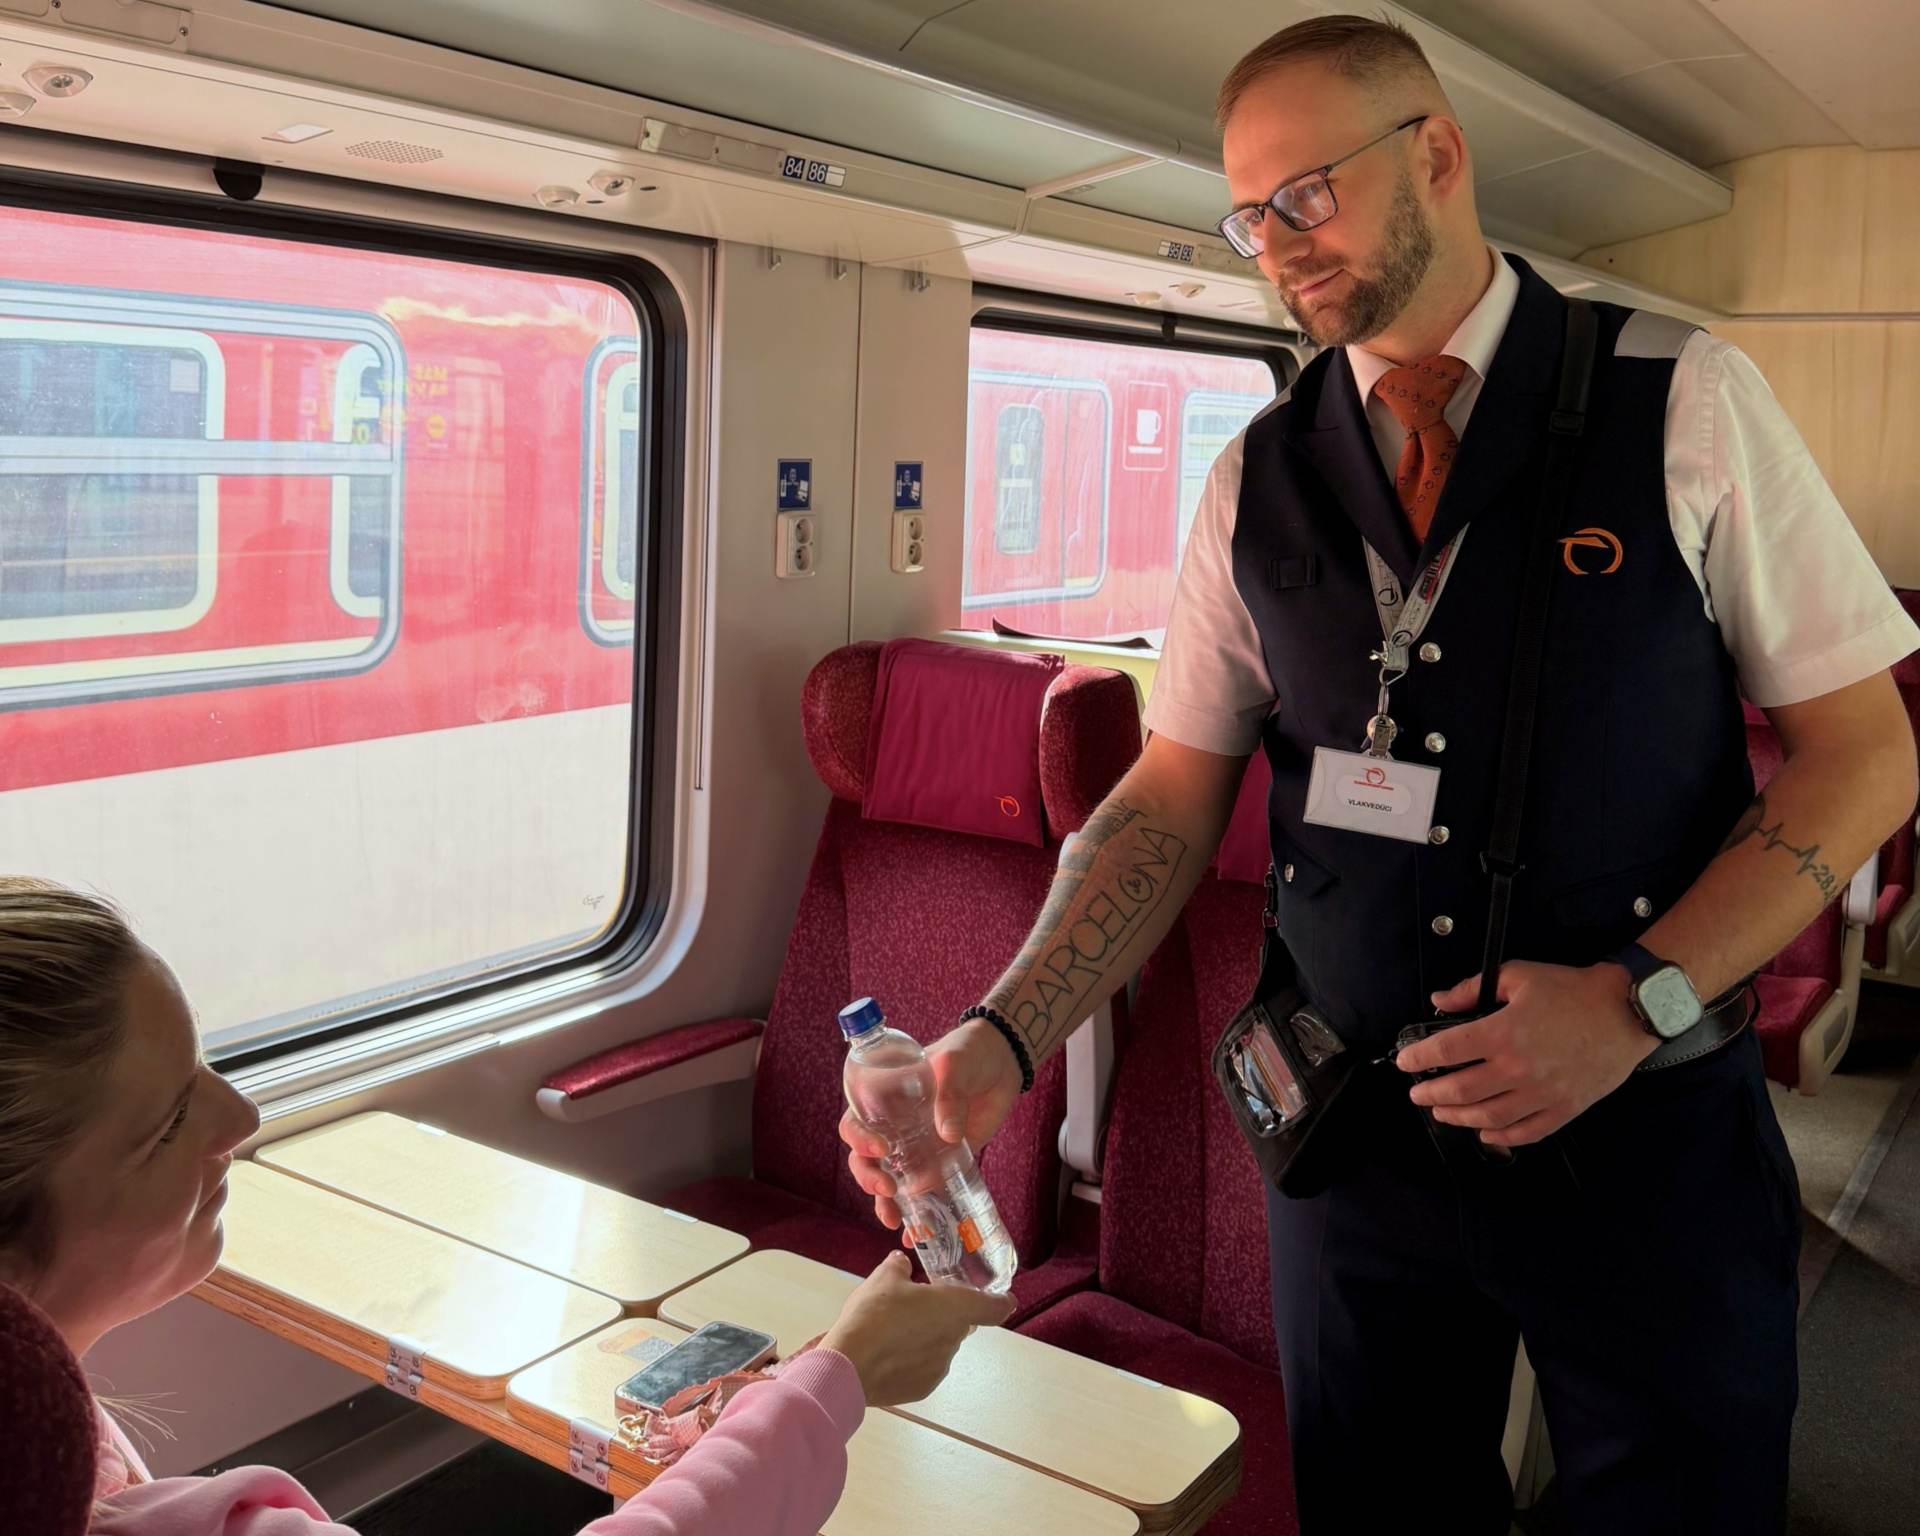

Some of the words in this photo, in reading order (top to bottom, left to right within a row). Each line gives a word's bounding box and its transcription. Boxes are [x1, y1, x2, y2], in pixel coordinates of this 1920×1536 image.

[785, 157, 804, 177] 84
[808, 162, 827, 182] 86
[1013, 826, 1187, 1049] BARCELONA
